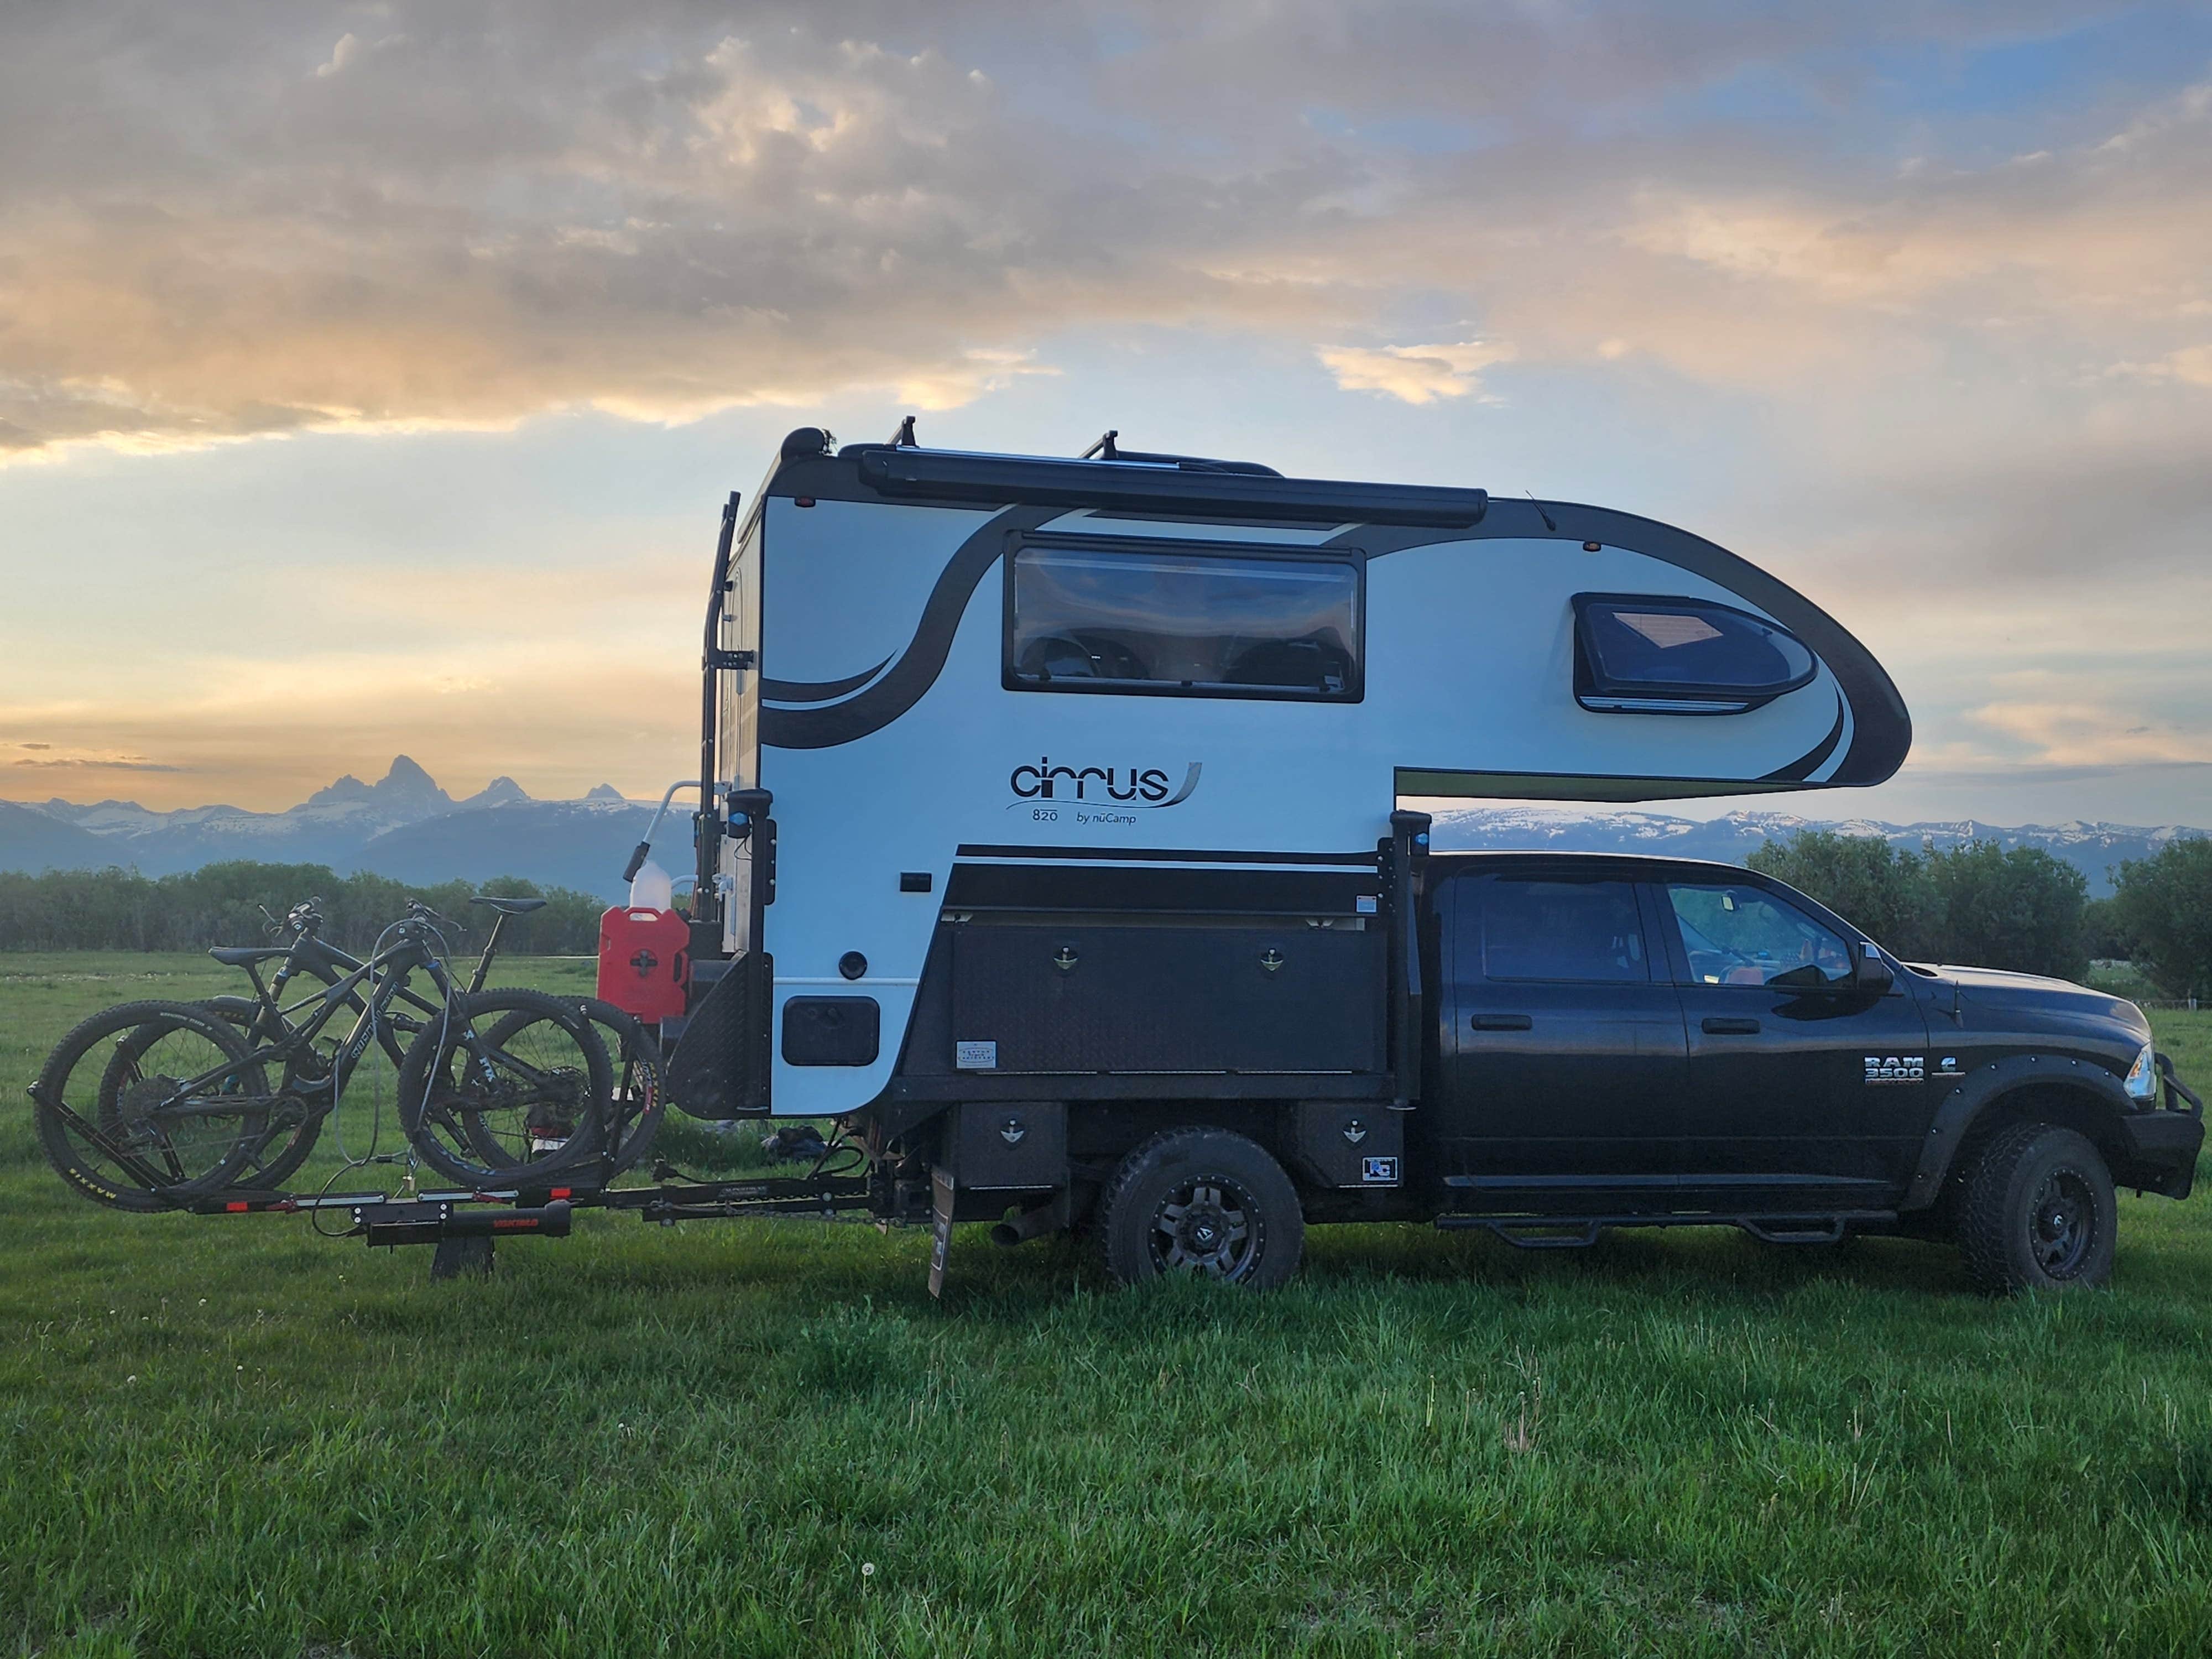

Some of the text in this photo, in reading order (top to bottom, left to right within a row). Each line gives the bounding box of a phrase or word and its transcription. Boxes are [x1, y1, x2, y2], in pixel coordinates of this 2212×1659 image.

[1010, 757, 1169, 801] cirrus
[1032, 809, 1058, 821] 820
[1077, 812, 1090, 825] by
[1864, 1057, 1924, 1067] RAM
[1865, 1068, 1924, 1078] 3500
[69, 1168, 117, 1199] MAXXIS
